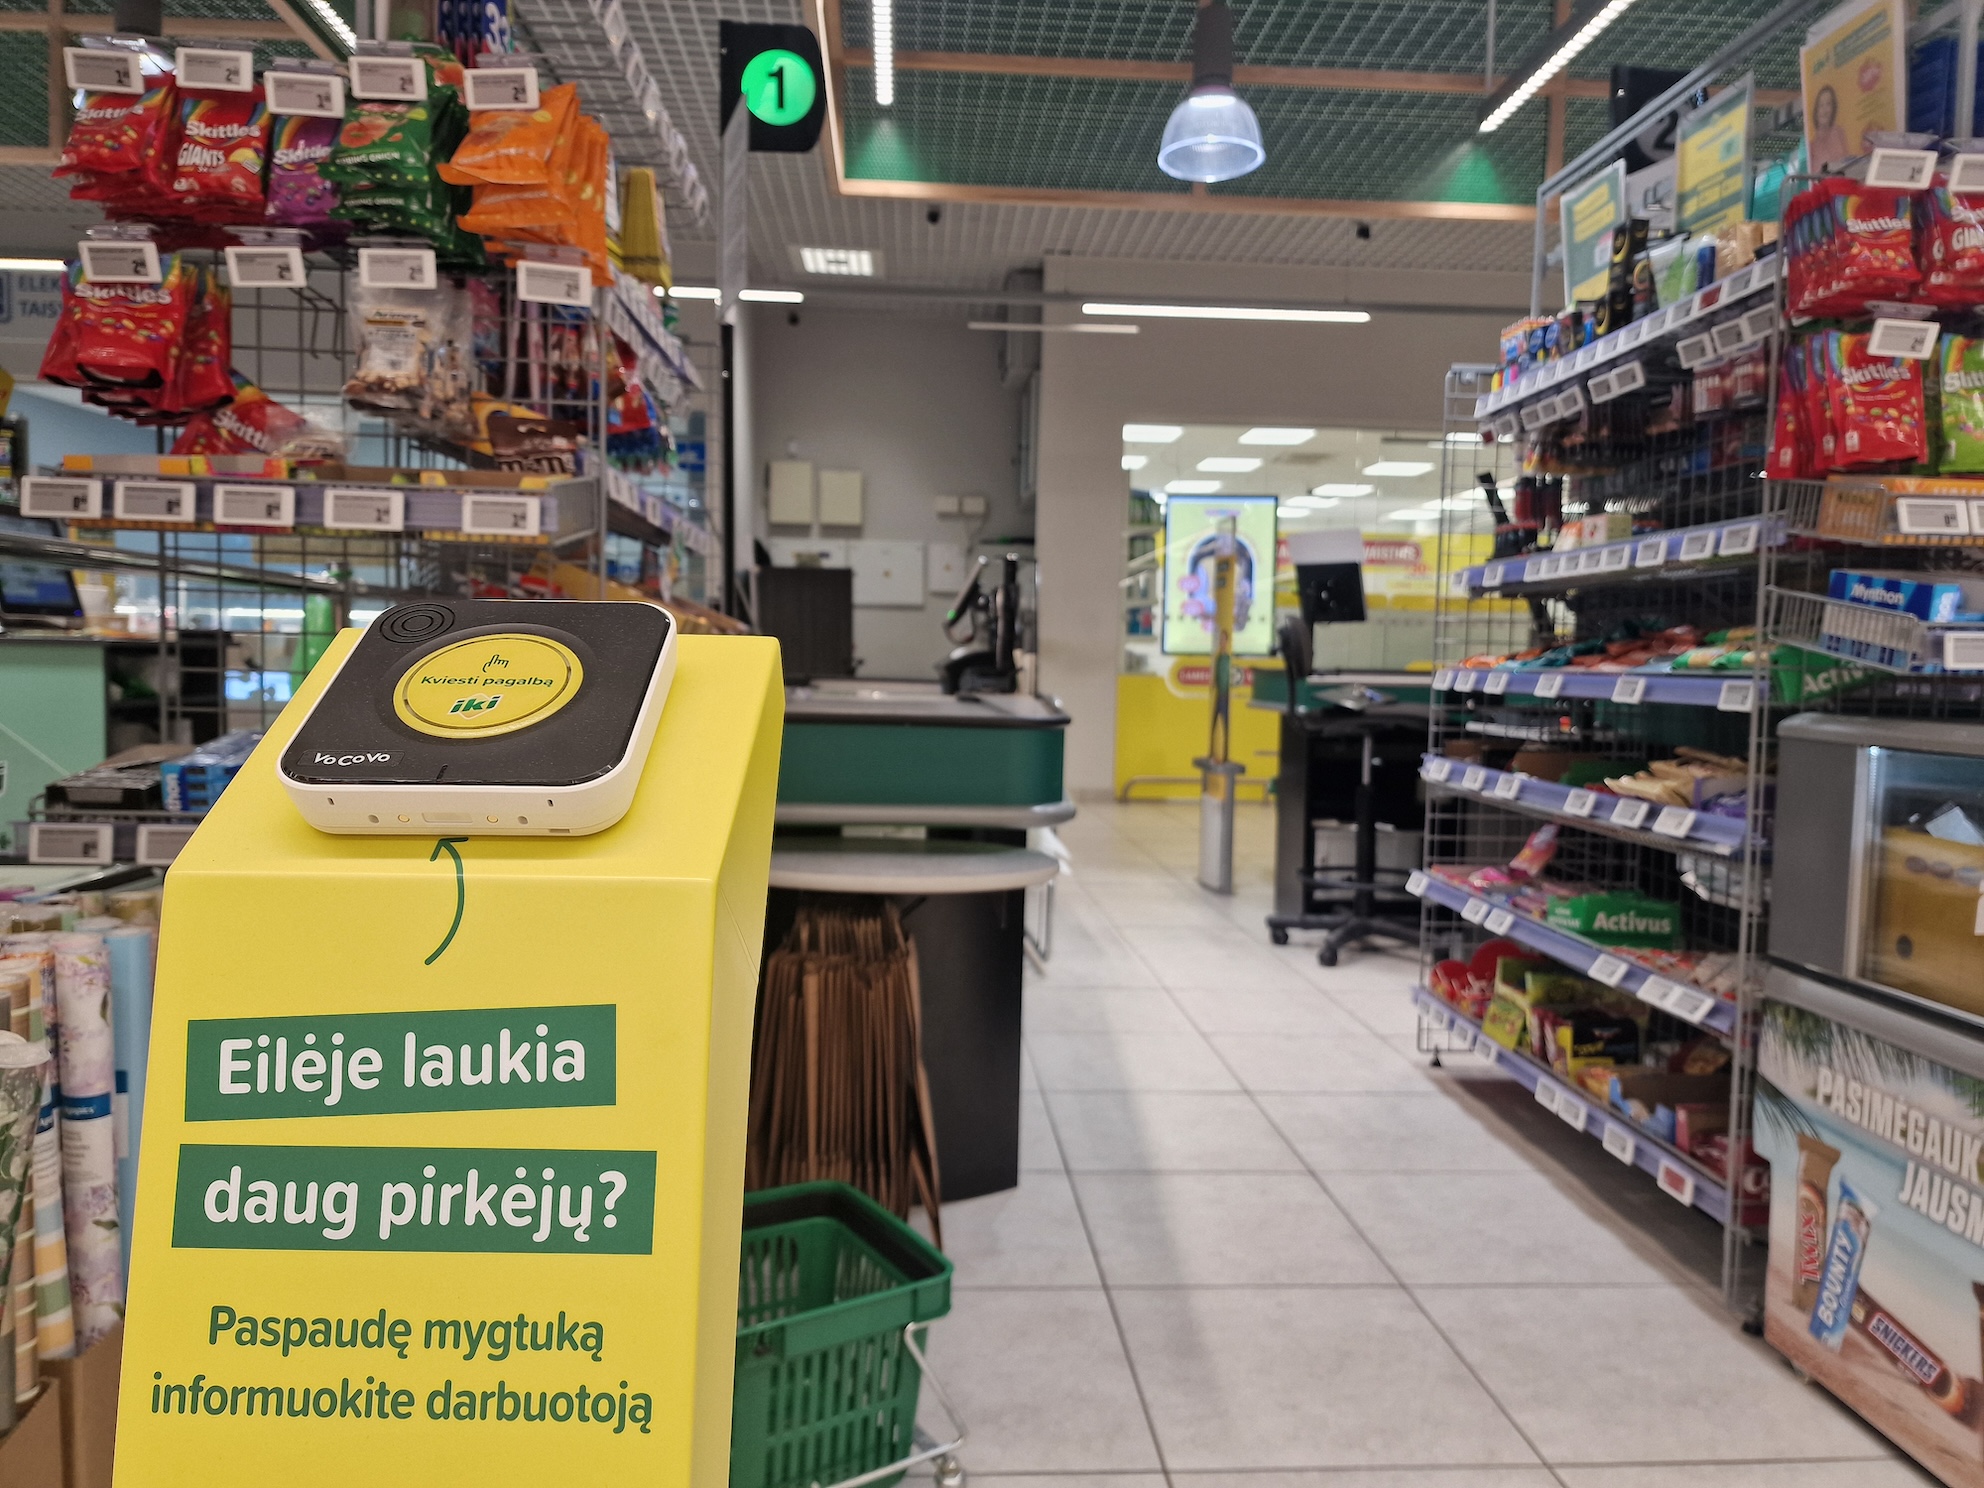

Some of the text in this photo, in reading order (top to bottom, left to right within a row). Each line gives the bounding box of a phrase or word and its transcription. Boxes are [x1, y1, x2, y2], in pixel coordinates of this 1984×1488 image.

[768, 66, 784, 109] 1
[184, 119, 262, 139] Skittles
[177, 142, 226, 167] GIANTS
[1847, 216, 1912, 233] Skittles
[1841, 362, 1912, 385] Skittles
[1850, 583, 1905, 605] Mynthon
[420, 675, 554, 688] Kviesti pagalbą
[450, 695, 502, 714] iki
[1592, 910, 1672, 934] Activus
[218, 1024, 587, 1107] Eilėje laukia
[203, 1164, 628, 1243] daug pirkėjų?
[1801, 1213, 1821, 1285] TWIX
[1817, 1228, 1853, 1328] BOUNTY
[207, 1304, 605, 1363] Paspaudę mygtuką
[1871, 1316, 1939, 1381] SNICKERS
[150, 1370, 654, 1436] informuokite darbuotoją
